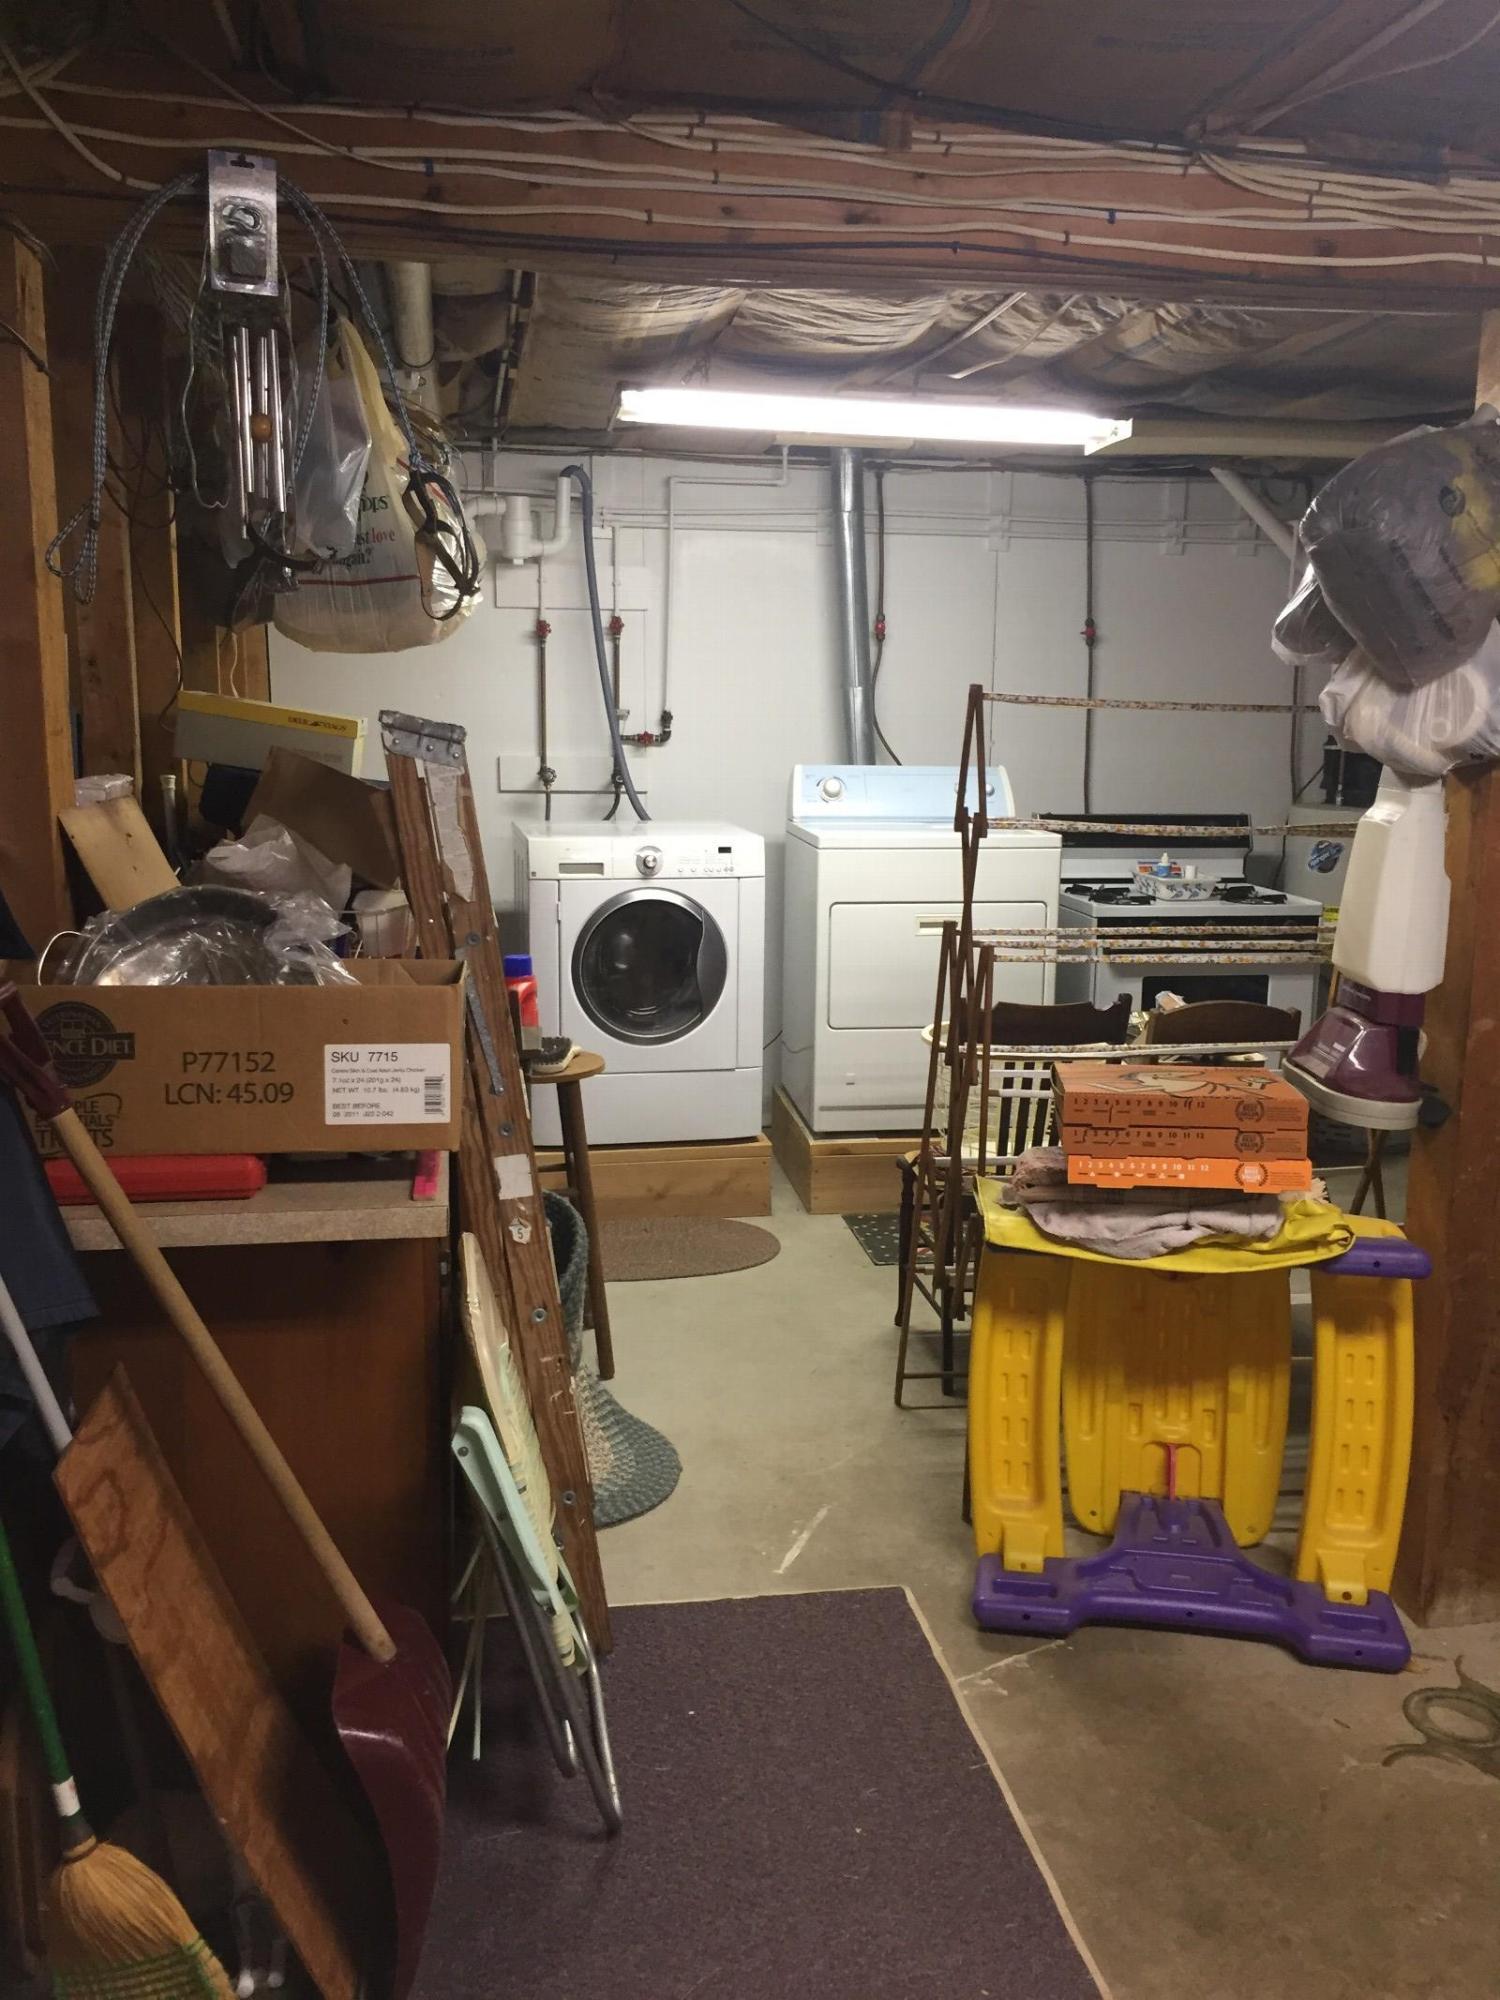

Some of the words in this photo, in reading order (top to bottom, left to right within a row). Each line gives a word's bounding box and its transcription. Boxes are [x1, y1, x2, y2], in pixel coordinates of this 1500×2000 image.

[371, 527, 396, 544] love
[91, 1038, 131, 1056] DIET
[182, 1051, 275, 1072] P77152
[331, 1051, 359, 1063] SKU
[368, 1052, 398, 1062] 7715
[165, 1083, 222, 1104] LCN:
[226, 1082, 294, 1104] 45.09
[517, 1227, 524, 1240] 5
